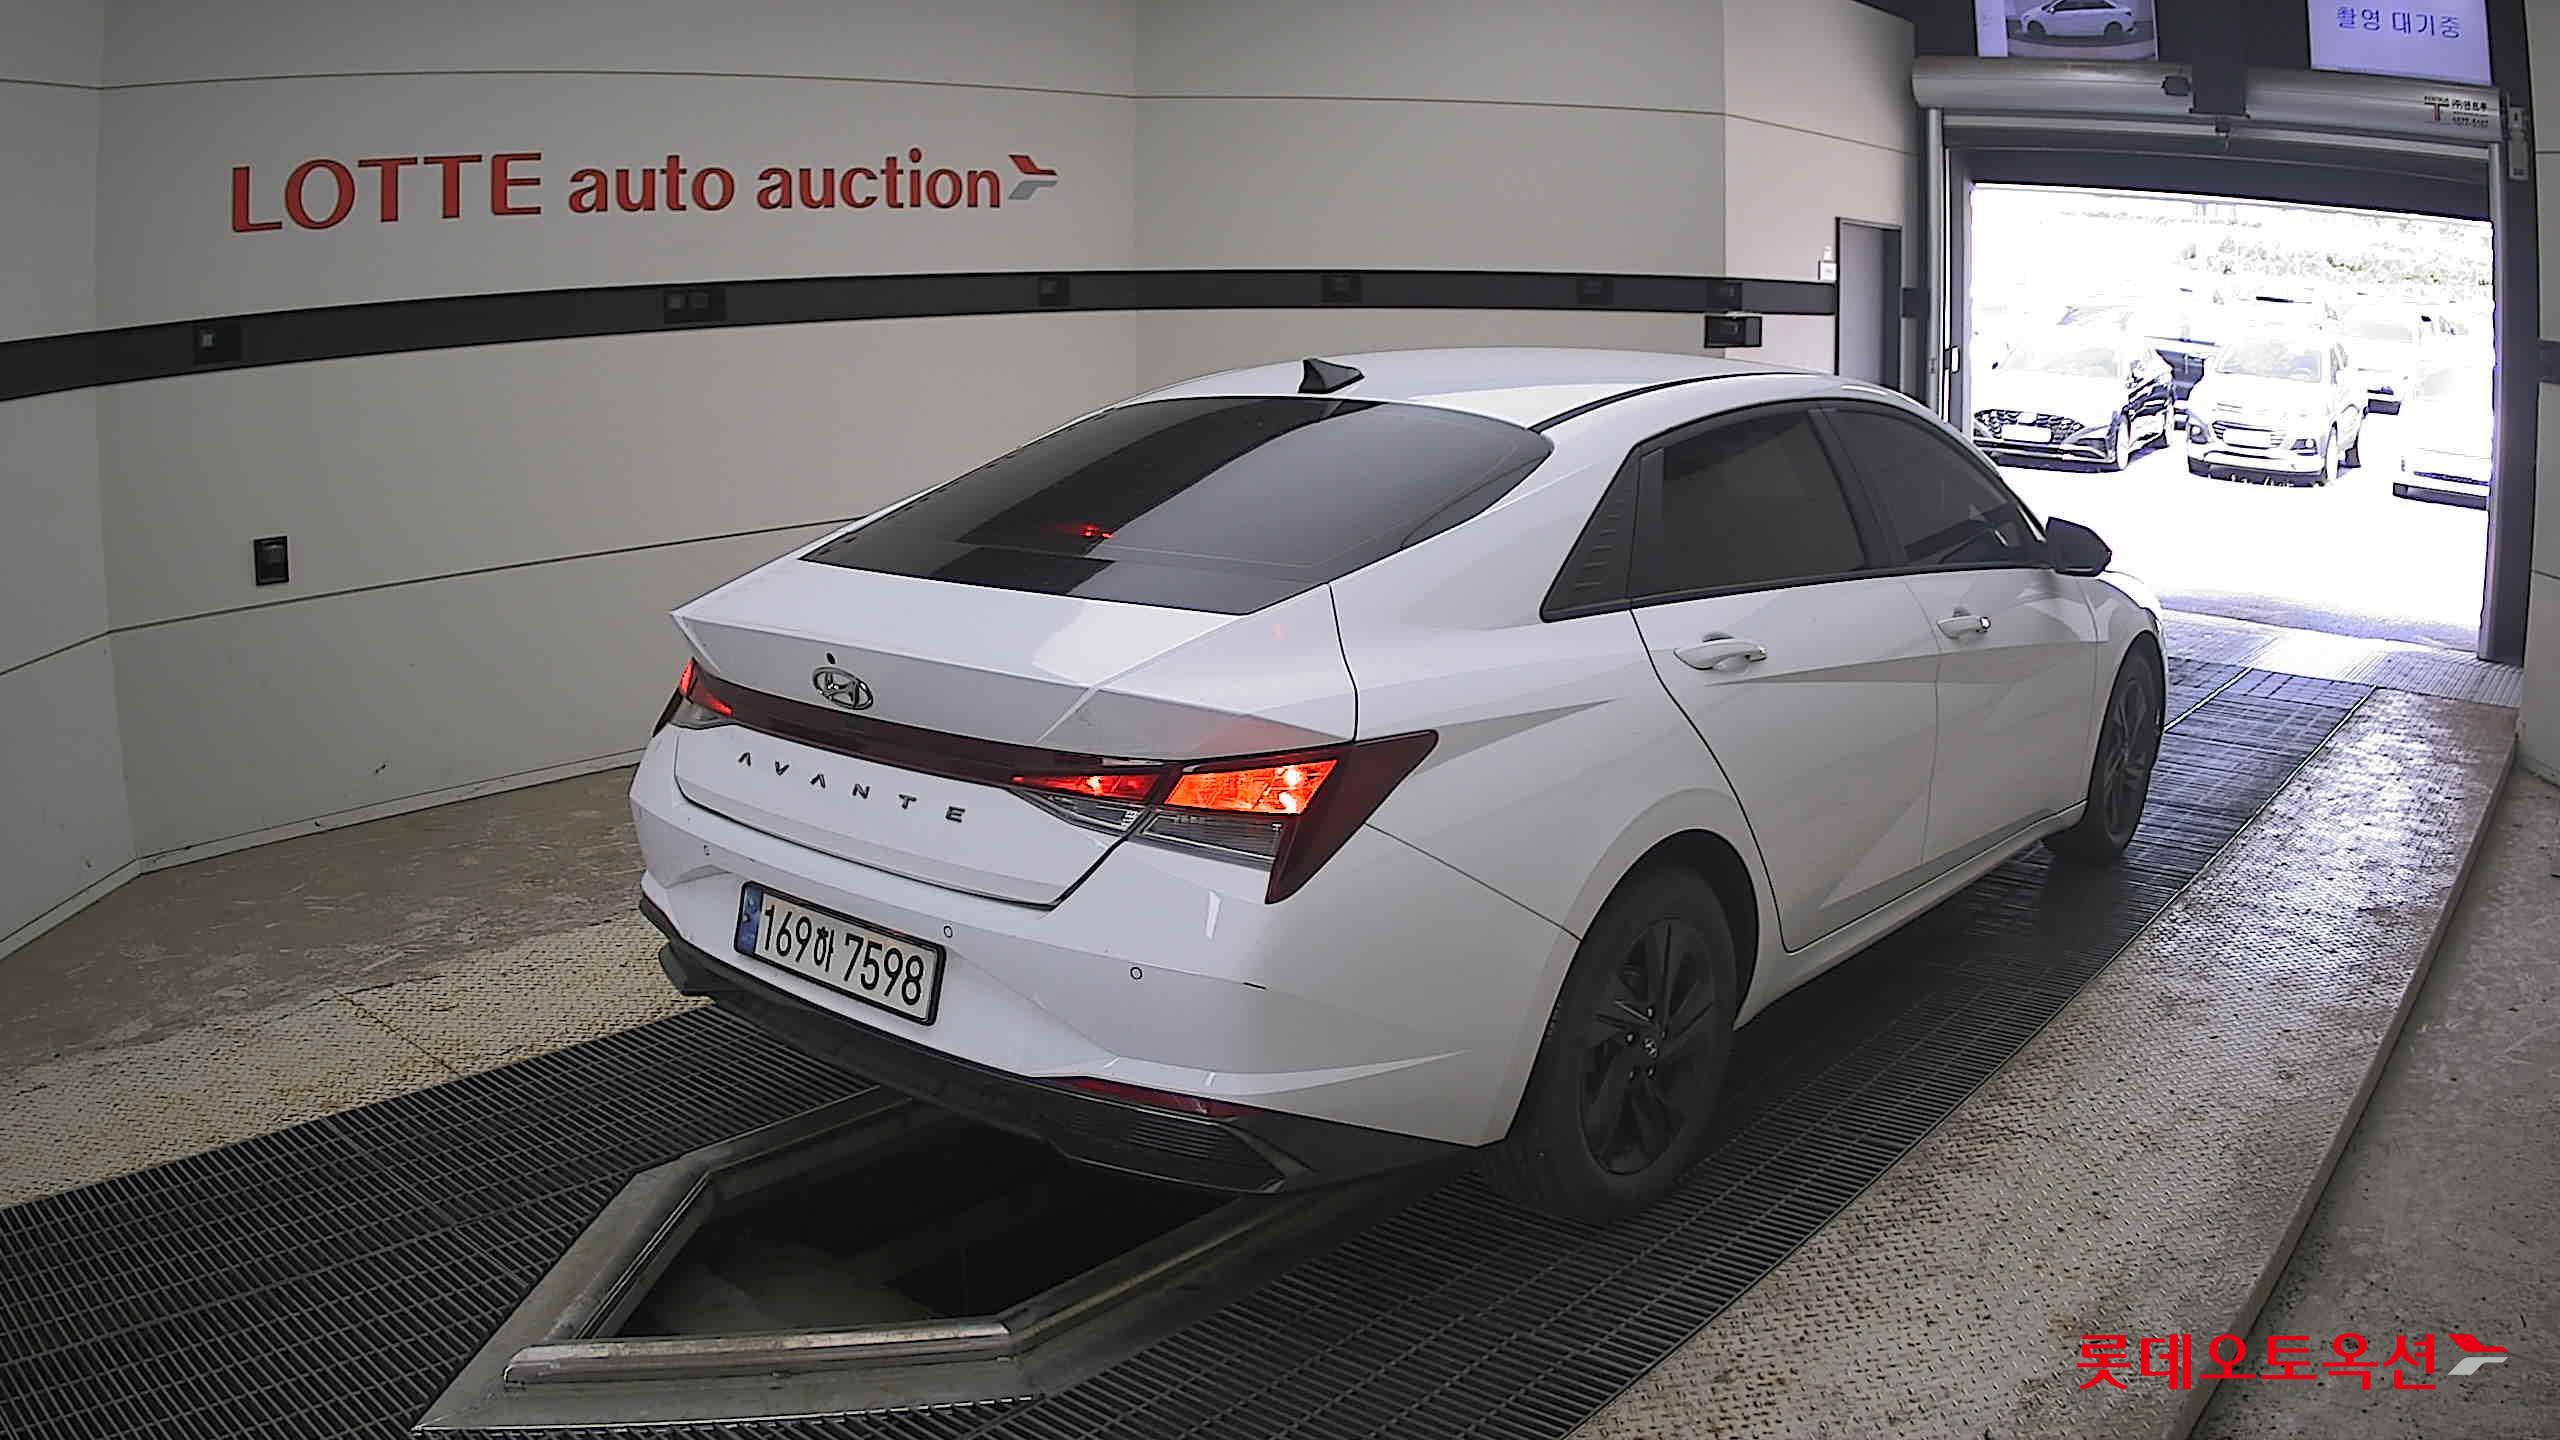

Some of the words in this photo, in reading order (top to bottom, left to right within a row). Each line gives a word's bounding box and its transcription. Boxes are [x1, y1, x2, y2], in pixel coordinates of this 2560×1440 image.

[2337, 7, 2381, 31] 촬영
[2391, 12, 2461, 39] 대기중
[231, 151, 542, 233] LOTTE
[567, 154, 736, 213] auto
[757, 147, 1001, 209] auction
[738, 751, 966, 823] AVANTE
[764, 904, 835, 972] 169하
[843, 932, 924, 1005] 7598
